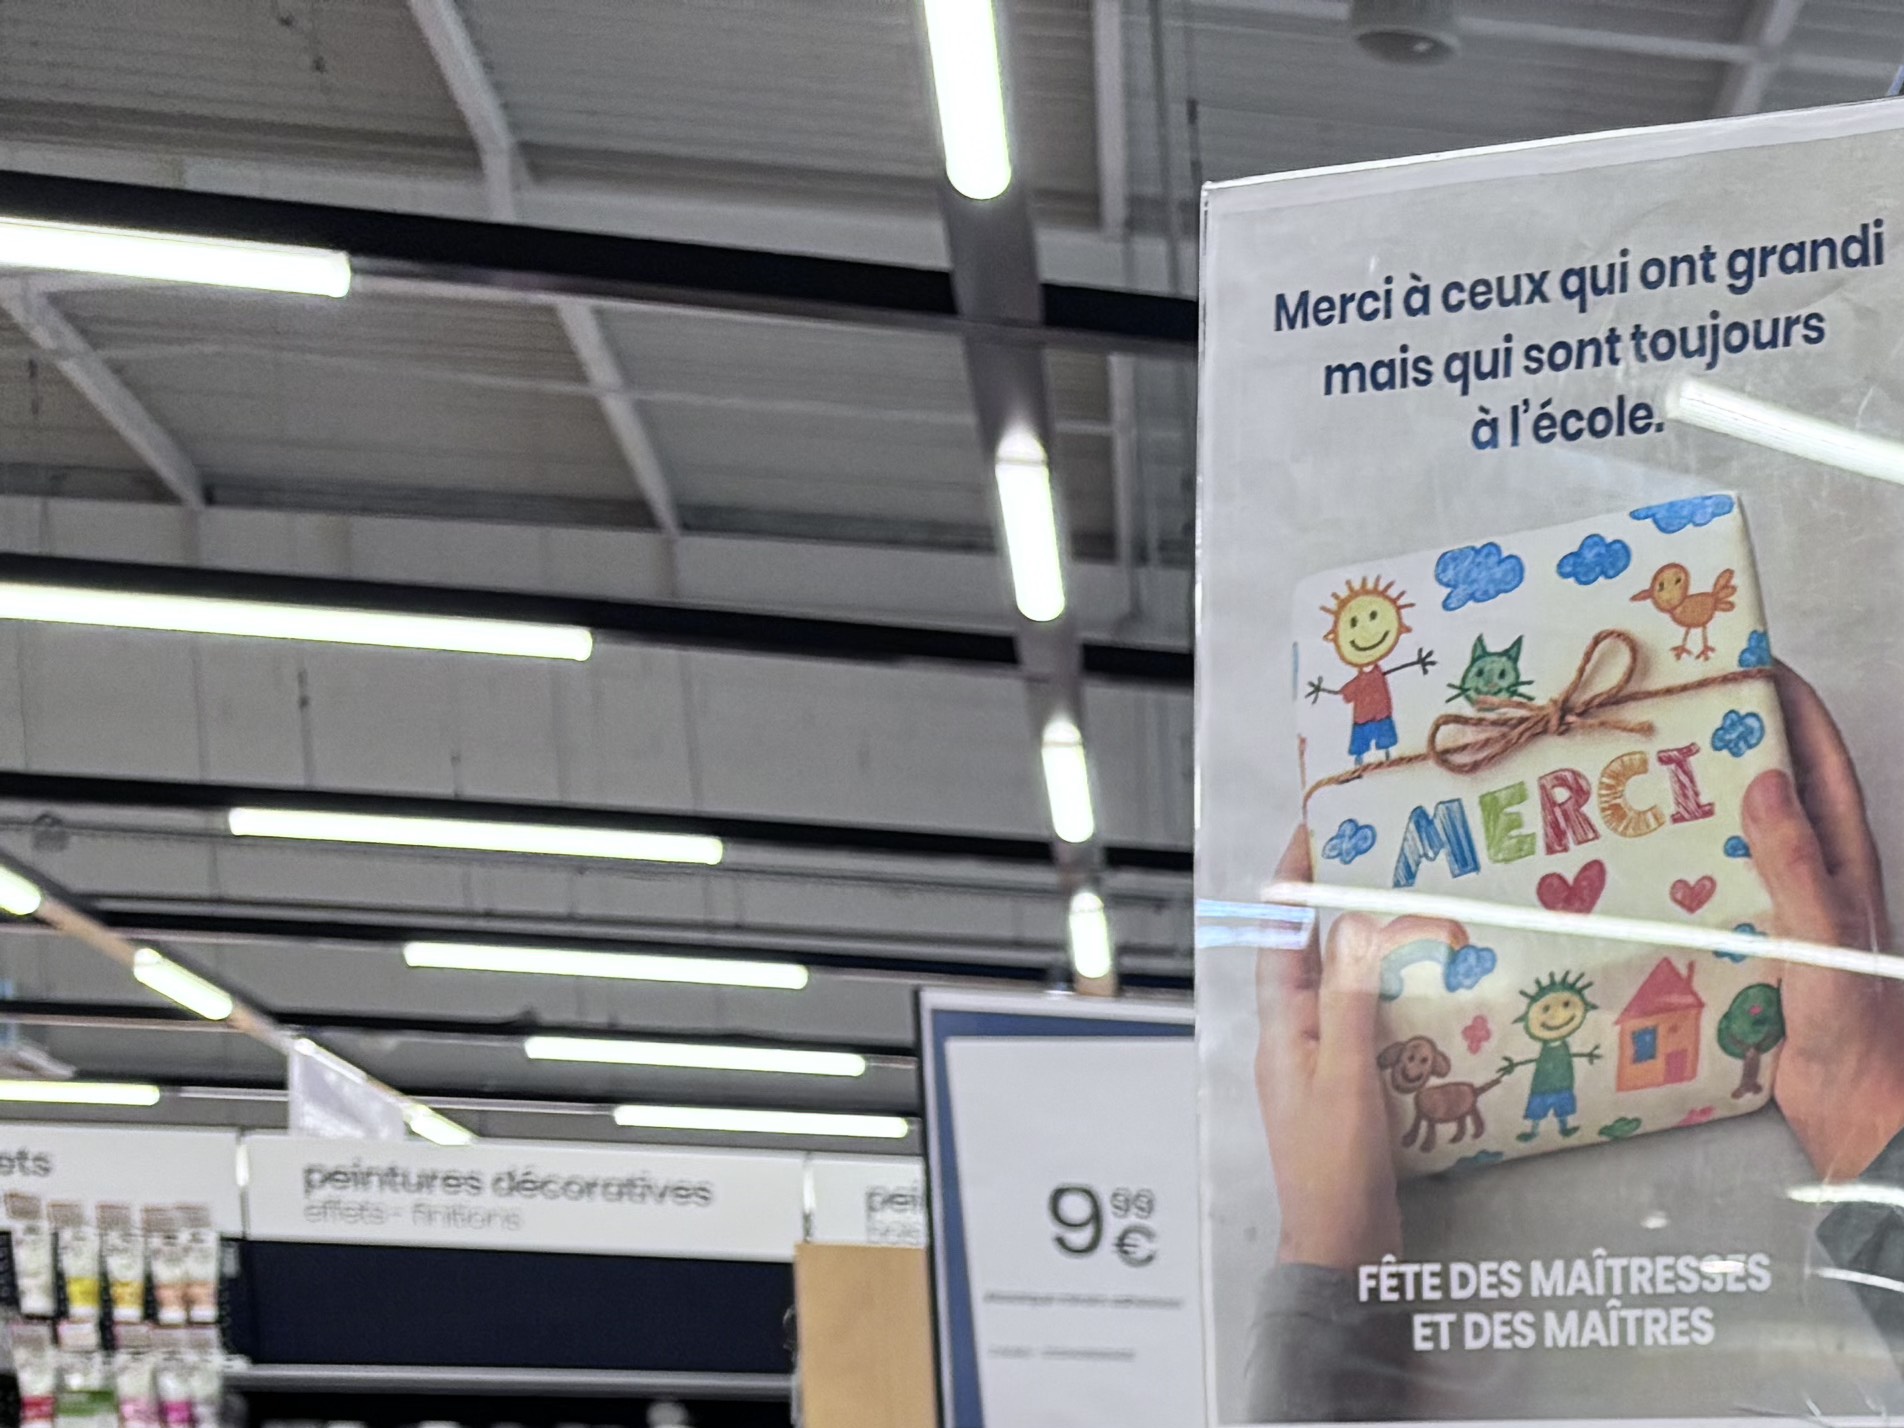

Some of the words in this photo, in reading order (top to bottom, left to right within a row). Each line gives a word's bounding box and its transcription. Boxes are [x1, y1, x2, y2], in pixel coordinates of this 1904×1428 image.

[1273, 278, 1393, 335] Merci
[1403, 273, 1434, 319] à
[1440, 265, 1551, 312] ceux
[1560, 248, 1631, 305] qui
[1639, 245, 1717, 288] ont
[1726, 218, 1886, 284] grandi
[1323, 341, 1434, 396] mais
[1442, 333, 1514, 389] qui
[1522, 331, 1621, 378] sont
[1629, 306, 1827, 371] toujours
[1470, 403, 1500, 451] à
[1392, 742, 1716, 889] MERCI
[0, 1149, 52, 1177] ets
[303, 1157, 482, 1199] peintures
[491, 1167, 714, 1208] décoratives
[304, 1201, 386, 1226] effets
[412, 1202, 523, 1231] finitions
[1049, 1184, 1105, 1257] 9
[1112, 1224, 1158, 1267] €
[1358, 1255, 1441, 1304] FÊTE
[1450, 1260, 1523, 1301] DES
[1530, 1249, 1772, 1299] MAÎTRESSES
[1413, 1311, 1456, 1351] ET
[1463, 1311, 1537, 1350] DES
[1544, 1300, 1716, 1349] MAÎTRES
